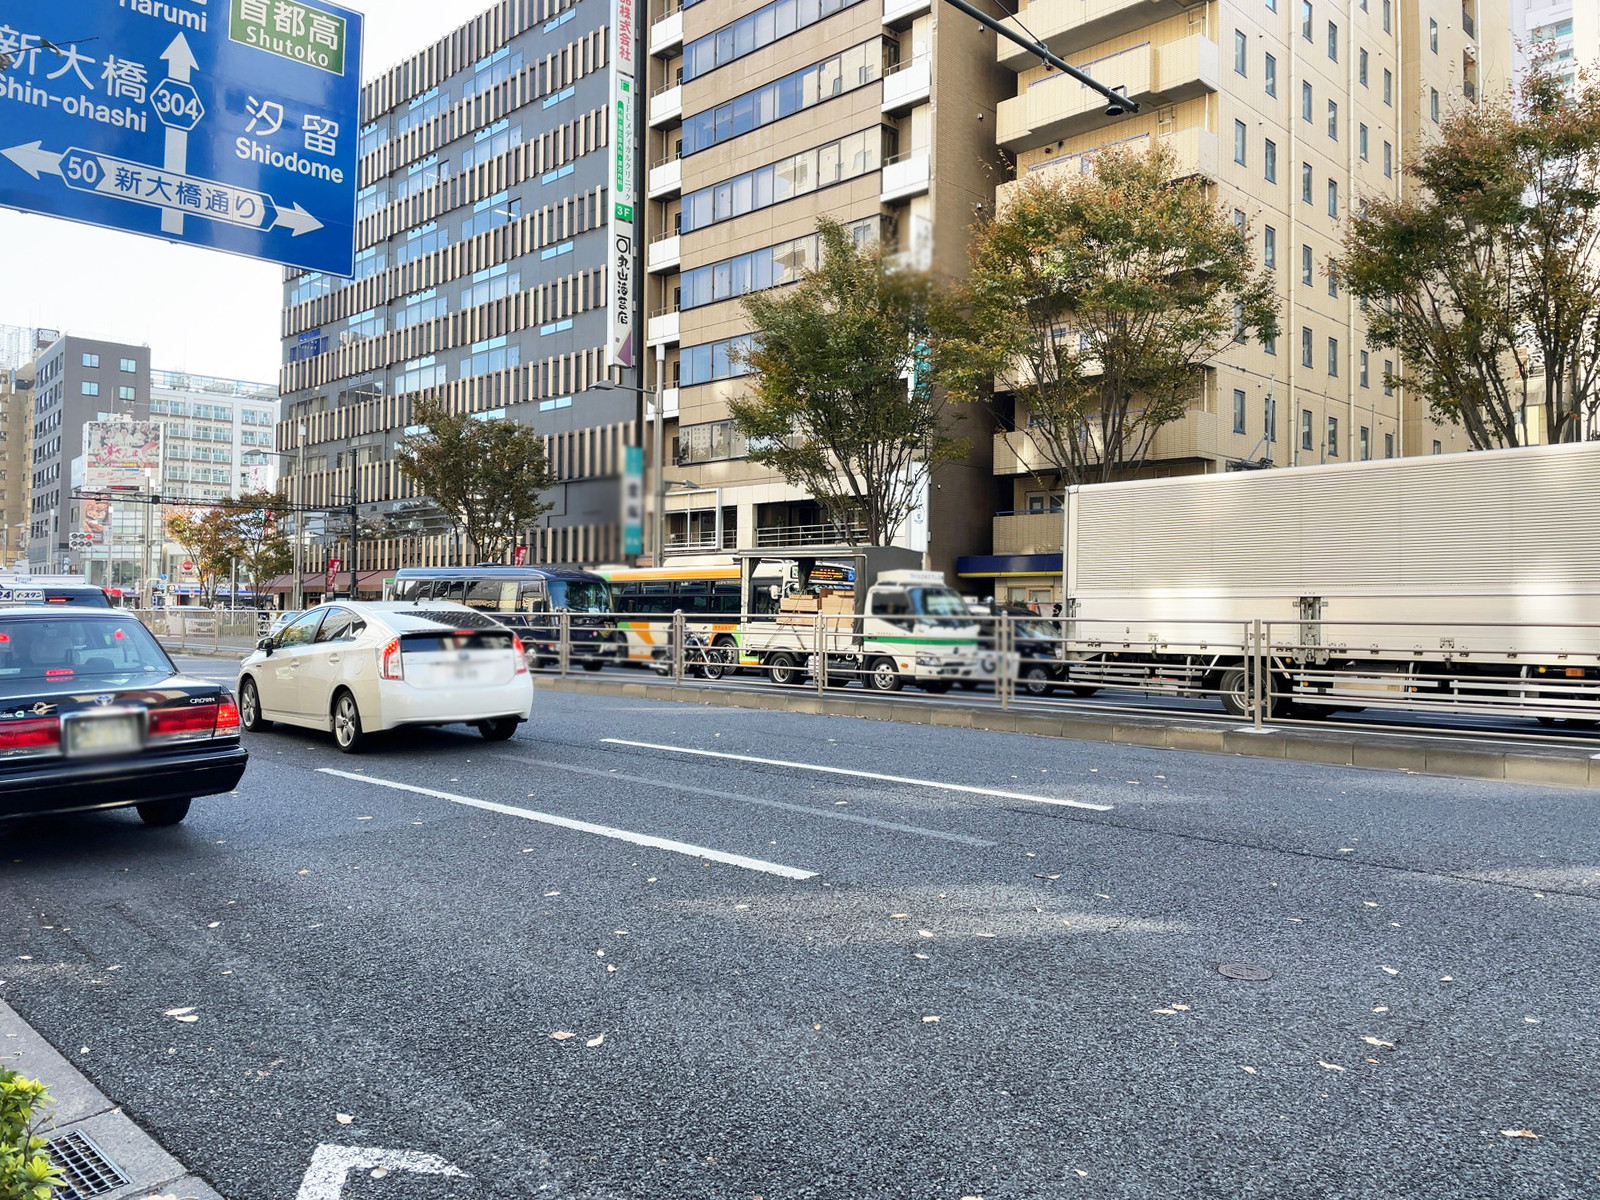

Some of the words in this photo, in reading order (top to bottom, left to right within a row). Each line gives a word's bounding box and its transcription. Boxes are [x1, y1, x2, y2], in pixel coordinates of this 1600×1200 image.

[240, 0, 340, 51] 首都高
[246, 26, 329, 67] Shutoko
[0, 24, 148, 104] 新大橋
[157, 89, 198, 120] 304
[245, 95, 339, 157] 汐留
[67, 156, 97, 183] 50
[235, 136, 343, 184] Shiodome
[114, 166, 256, 219] 新大橋通り
[617, 205, 631, 217] 3F
